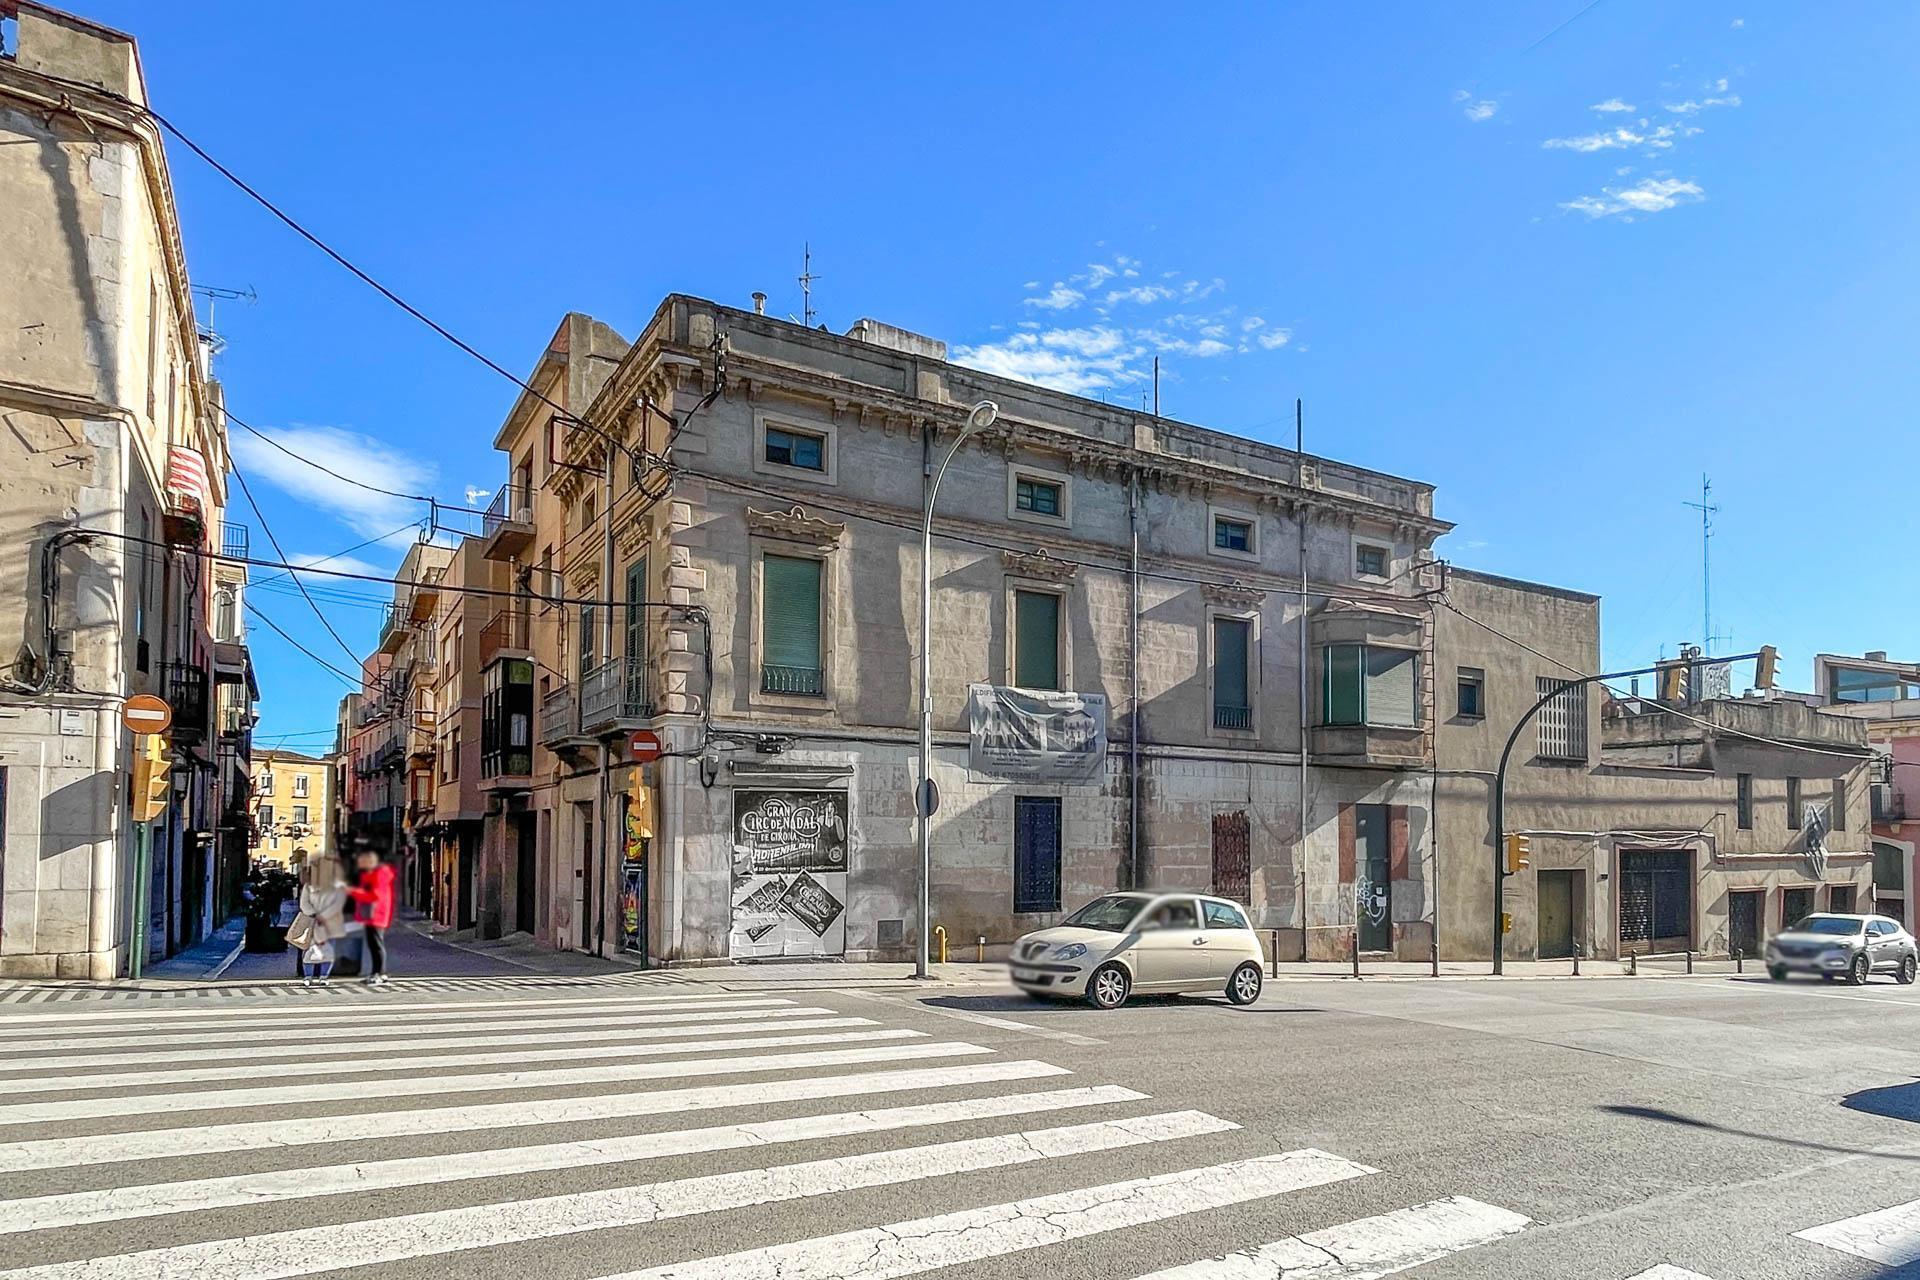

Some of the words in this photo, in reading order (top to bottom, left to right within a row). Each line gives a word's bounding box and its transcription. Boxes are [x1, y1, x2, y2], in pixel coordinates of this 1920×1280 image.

[764, 800, 791, 817] GRAN
[742, 812, 770, 833] CIRC
[770, 819, 782, 830] DE
[782, 808, 820, 836] NADAL
[770, 832, 797, 842] GIRONA
